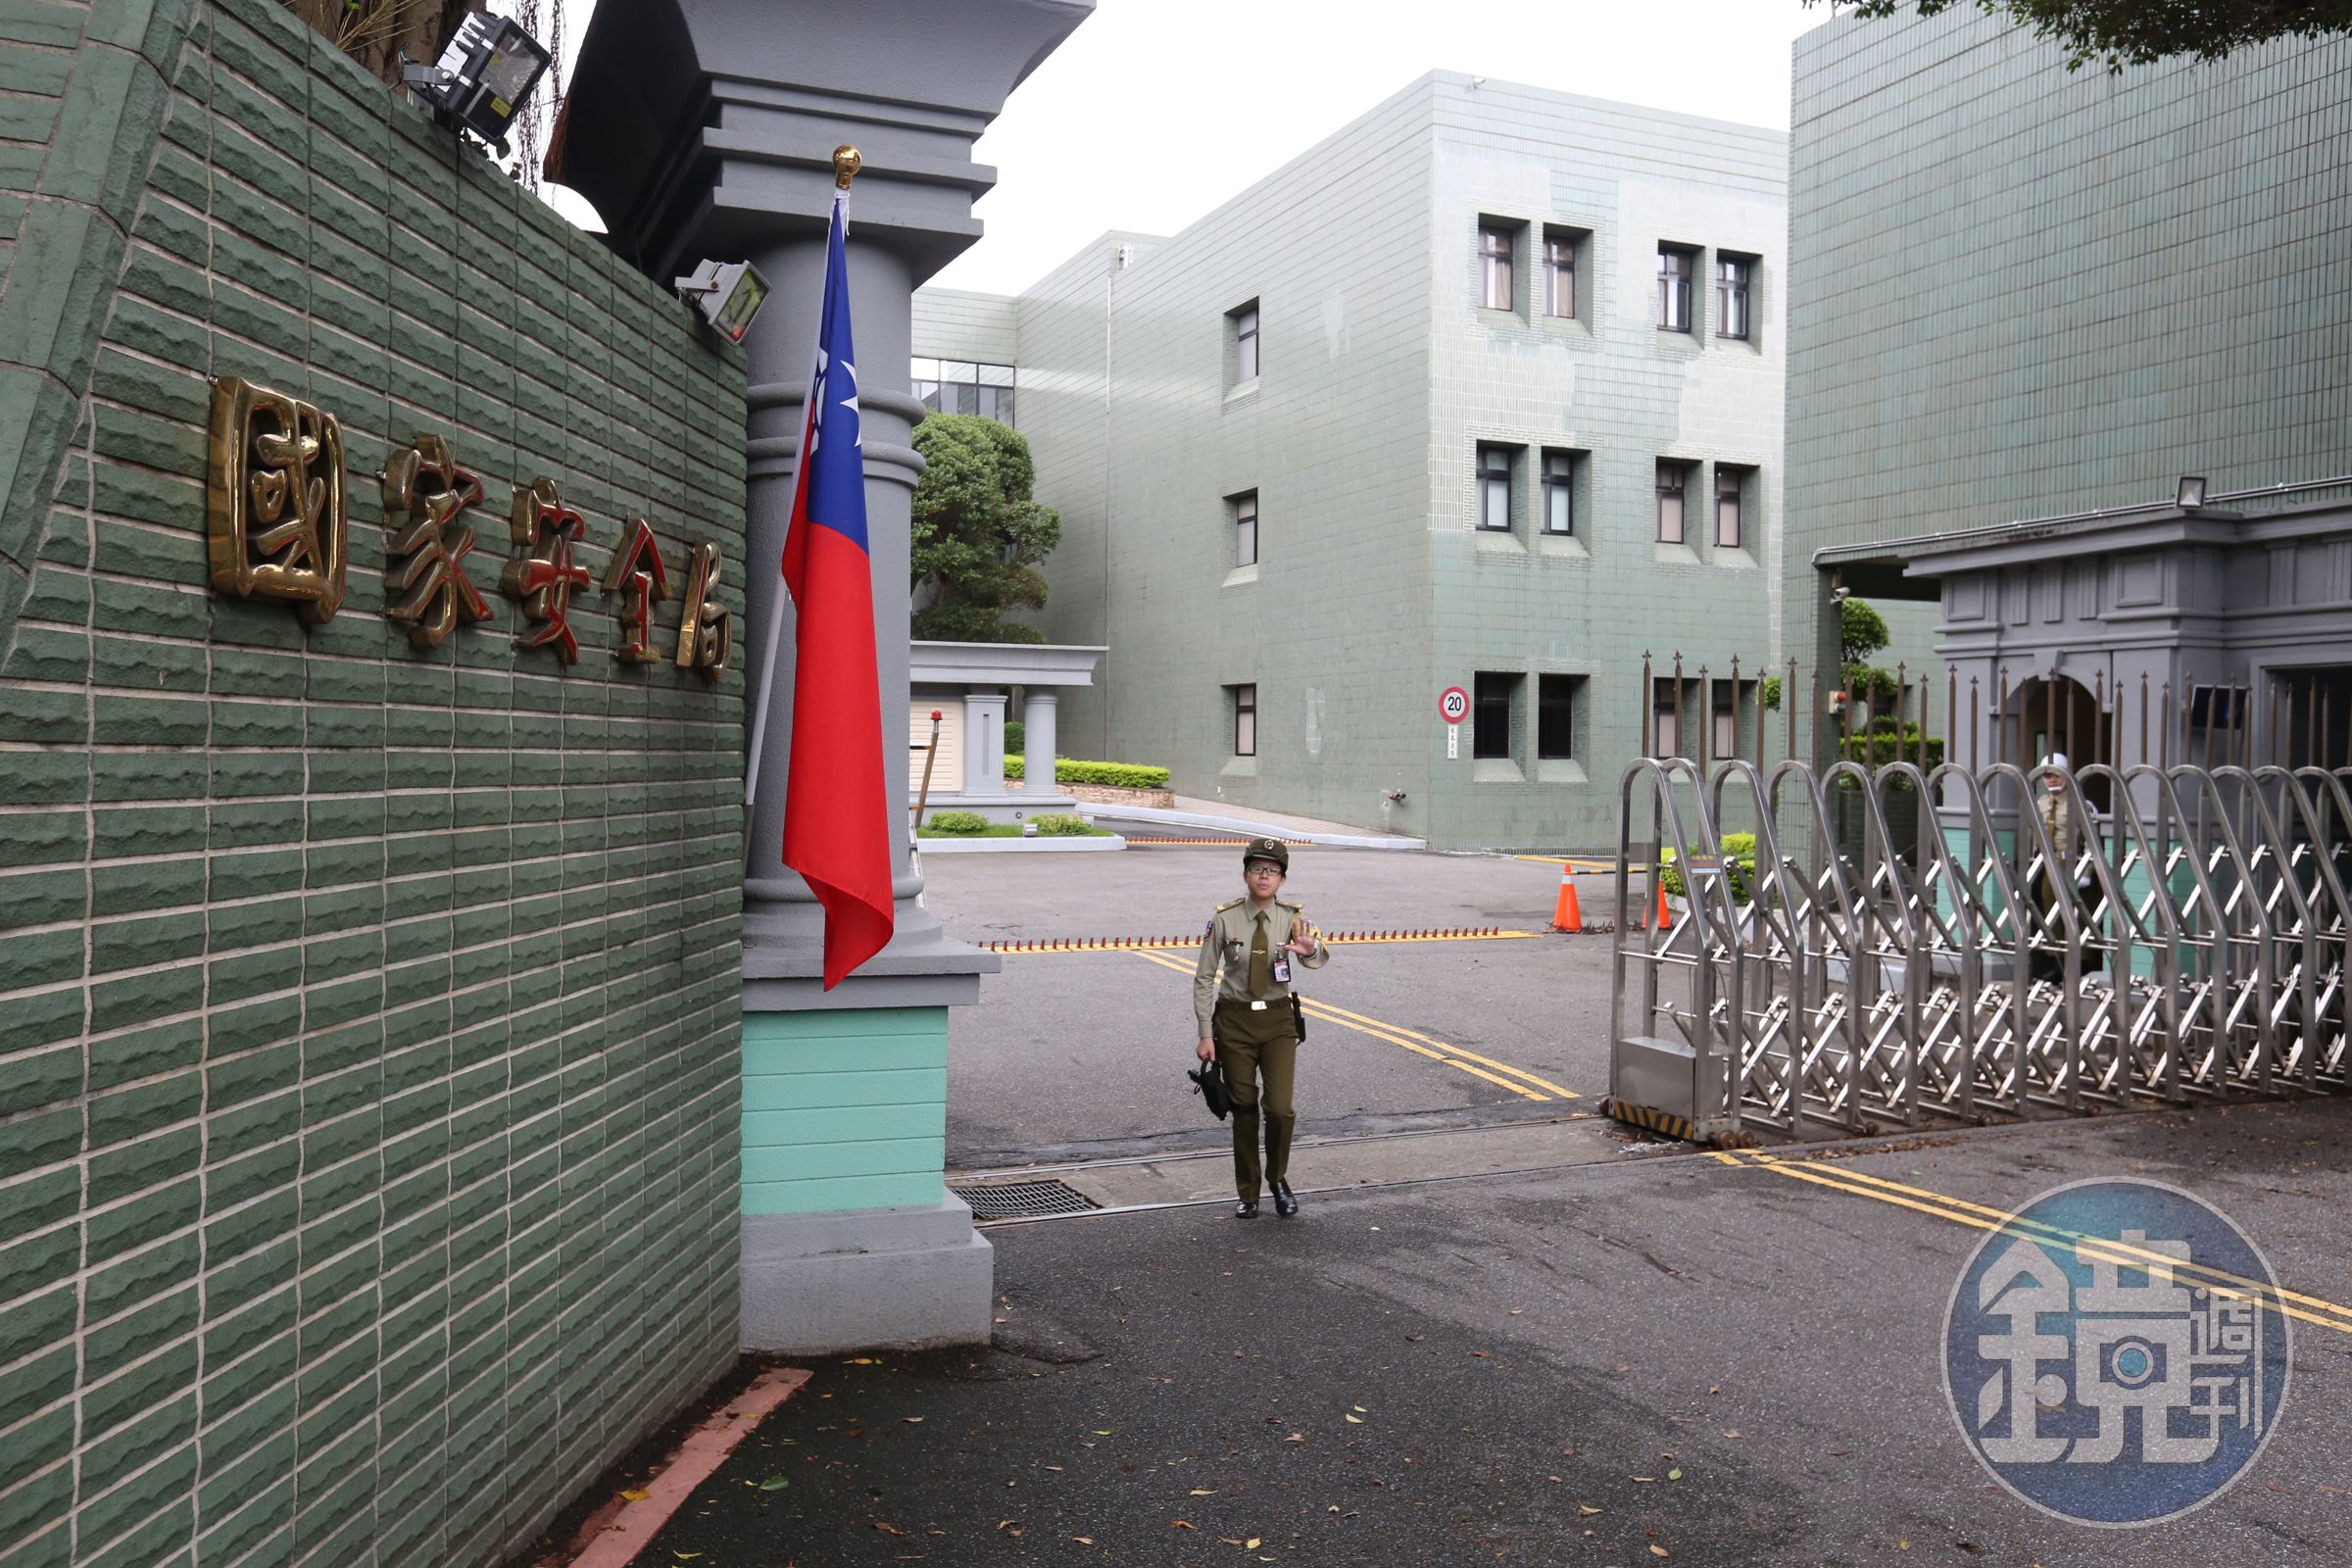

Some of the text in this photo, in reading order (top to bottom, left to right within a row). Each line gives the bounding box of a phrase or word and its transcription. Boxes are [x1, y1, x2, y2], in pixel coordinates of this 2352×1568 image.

[208, 375, 732, 680] 國家安全局
[1447, 697, 1461, 710] 20
